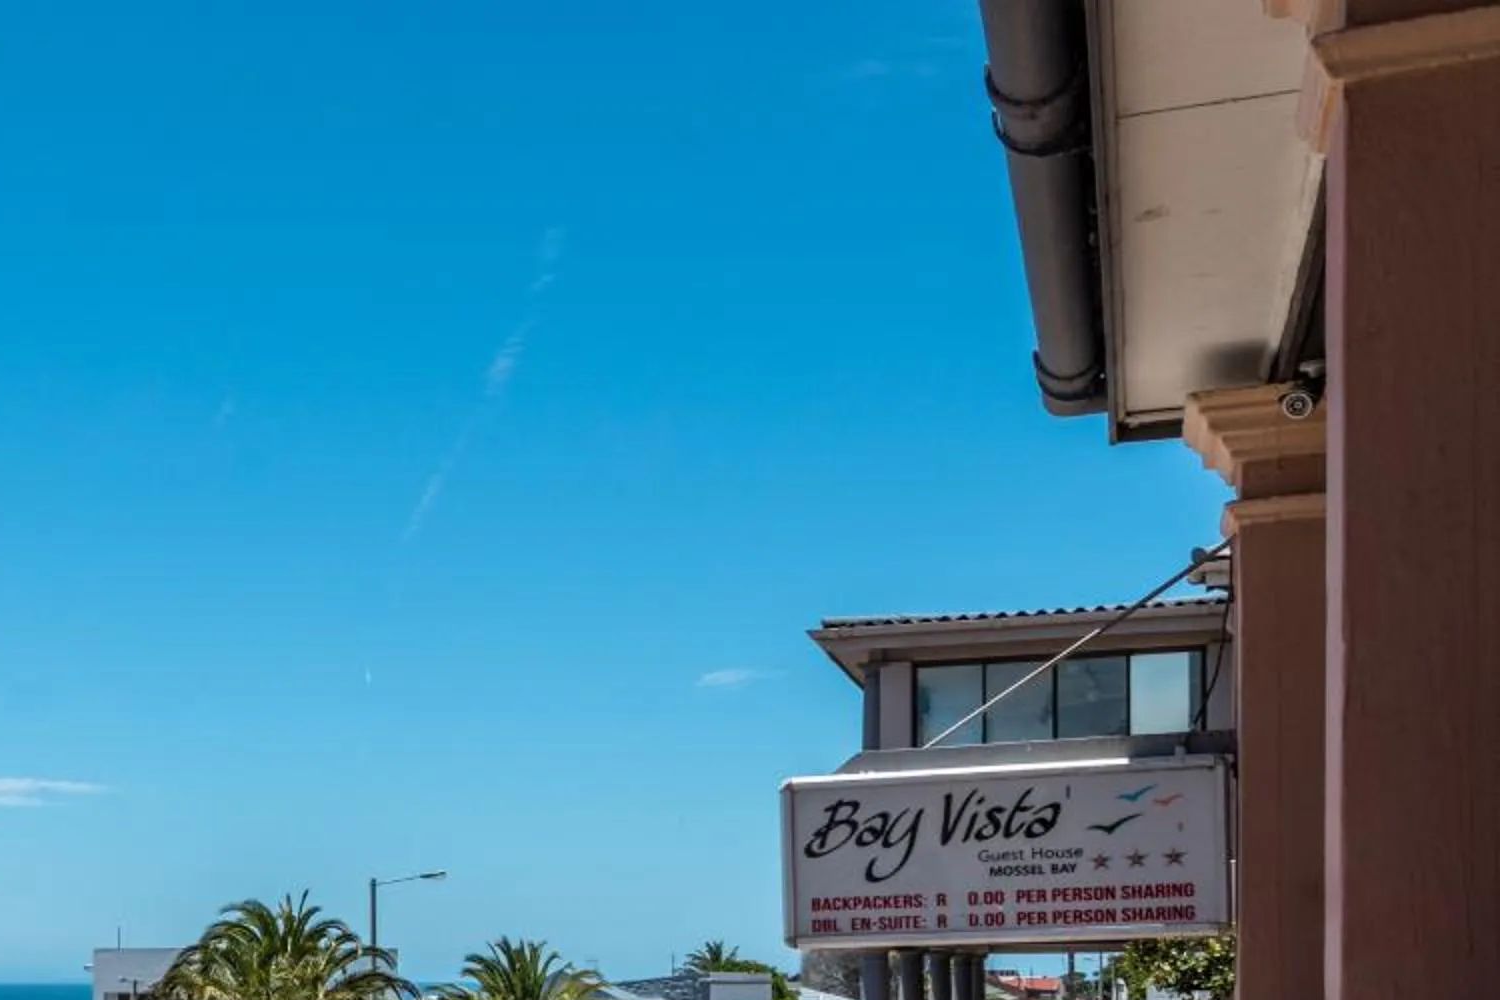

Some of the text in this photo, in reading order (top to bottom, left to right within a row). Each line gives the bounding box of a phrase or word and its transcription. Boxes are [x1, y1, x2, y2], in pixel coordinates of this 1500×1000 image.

[804, 788, 1062, 883] Bay Vista
[978, 847, 1084, 863] Guest House
[989, 863, 1078, 877] MOSSEL BAY
[811, 893, 928, 912] BACKPACKERS:
[936, 893, 948, 907] R
[1015, 889, 1048, 904] PER
[1051, 885, 1117, 903] PERSON
[1120, 881, 1196, 899] SHARING
[937, 913, 948, 929] R
[1016, 911, 1048, 926] PER
[1052, 908, 1117, 924] PERSON
[1121, 904, 1196, 922] SHARING
